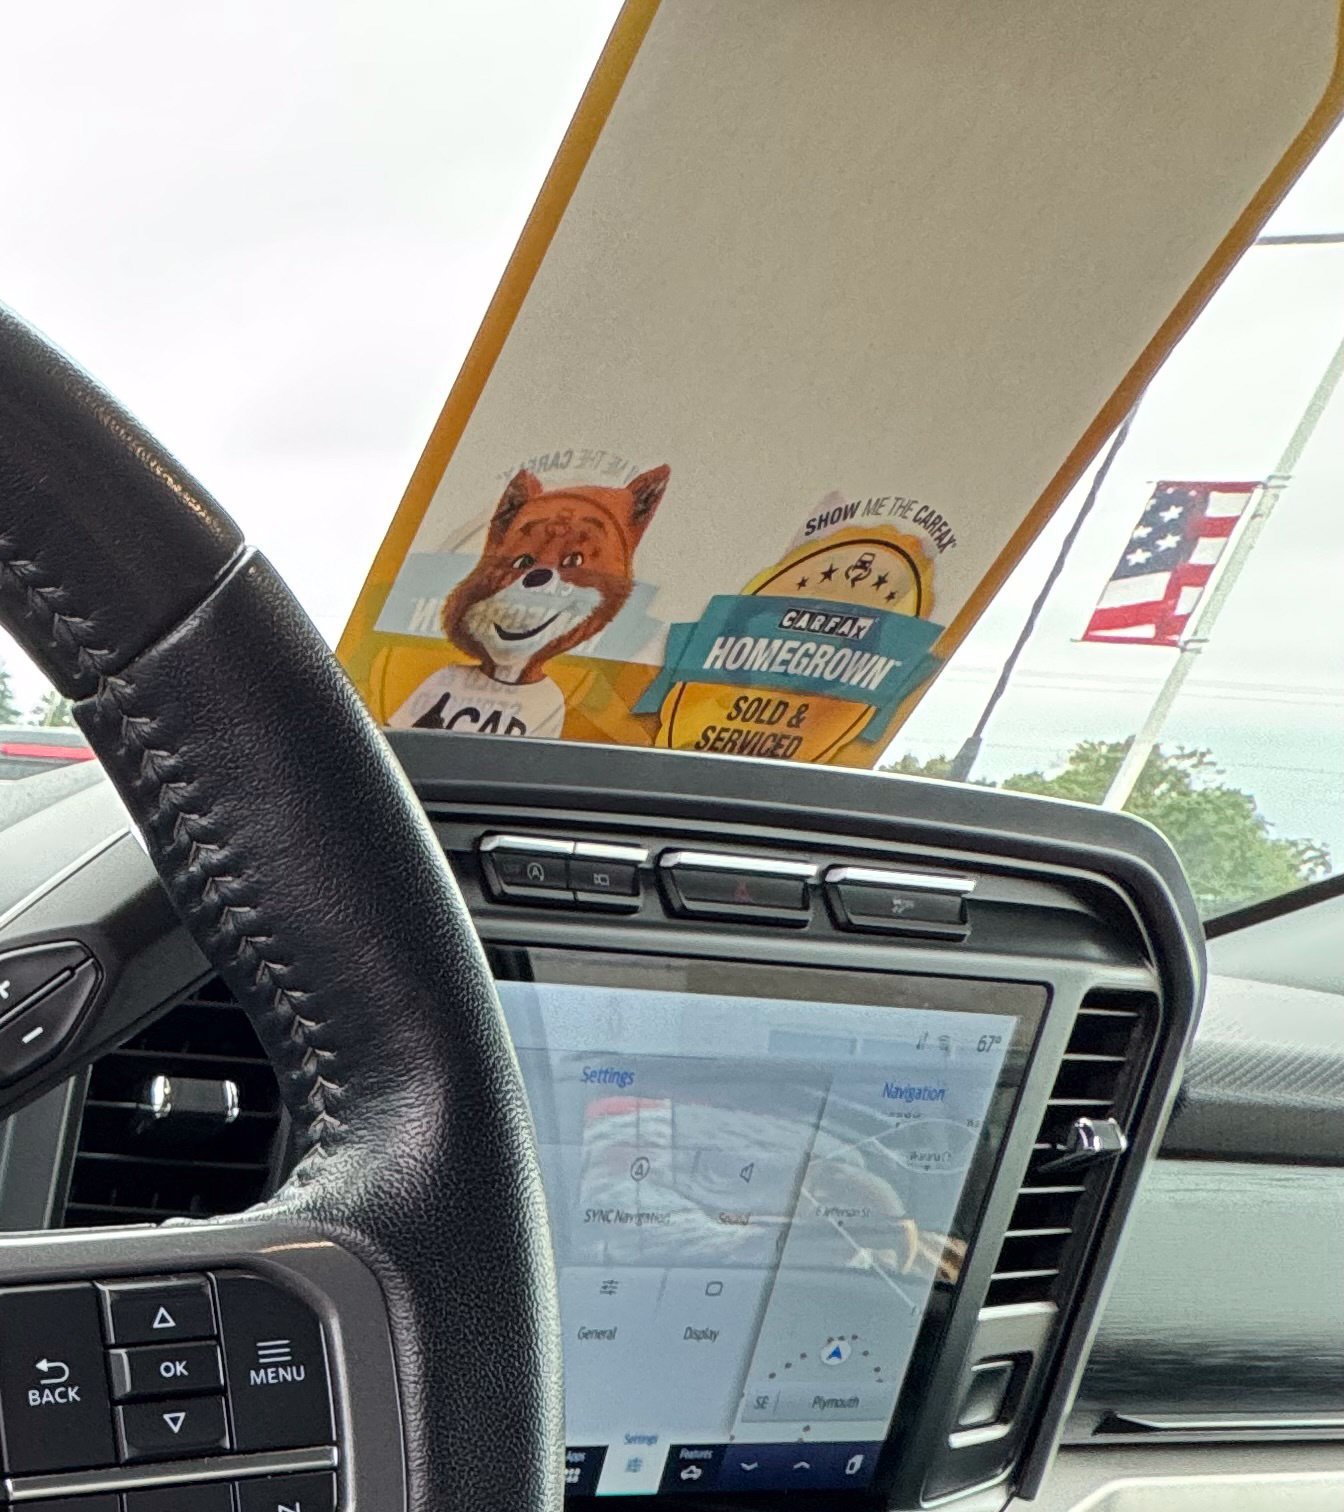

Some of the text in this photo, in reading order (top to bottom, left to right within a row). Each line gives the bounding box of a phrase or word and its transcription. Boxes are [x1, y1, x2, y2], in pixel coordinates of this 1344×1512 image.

[805, 500, 861, 536] SHOW
[862, 496, 891, 517] ME
[888, 496, 918, 518] THE
[778, 609, 874, 639] CARFAX
[703, 636, 895, 690] HOMEGROWN
[726, 696, 809, 728] SOLD &
[694, 725, 803, 759] SERVICED
[581, 1066, 636, 1088] Settings
[883, 1081, 946, 1103] Navigation
[583, 1207, 614, 1223] SYNC
[577, 1325, 618, 1342] General
[683, 1325, 720, 1342] Display
[160, 1361, 188, 1378] OK
[250, 1366, 305, 1386] MENU
[28, 1386, 81, 1406] BACK
